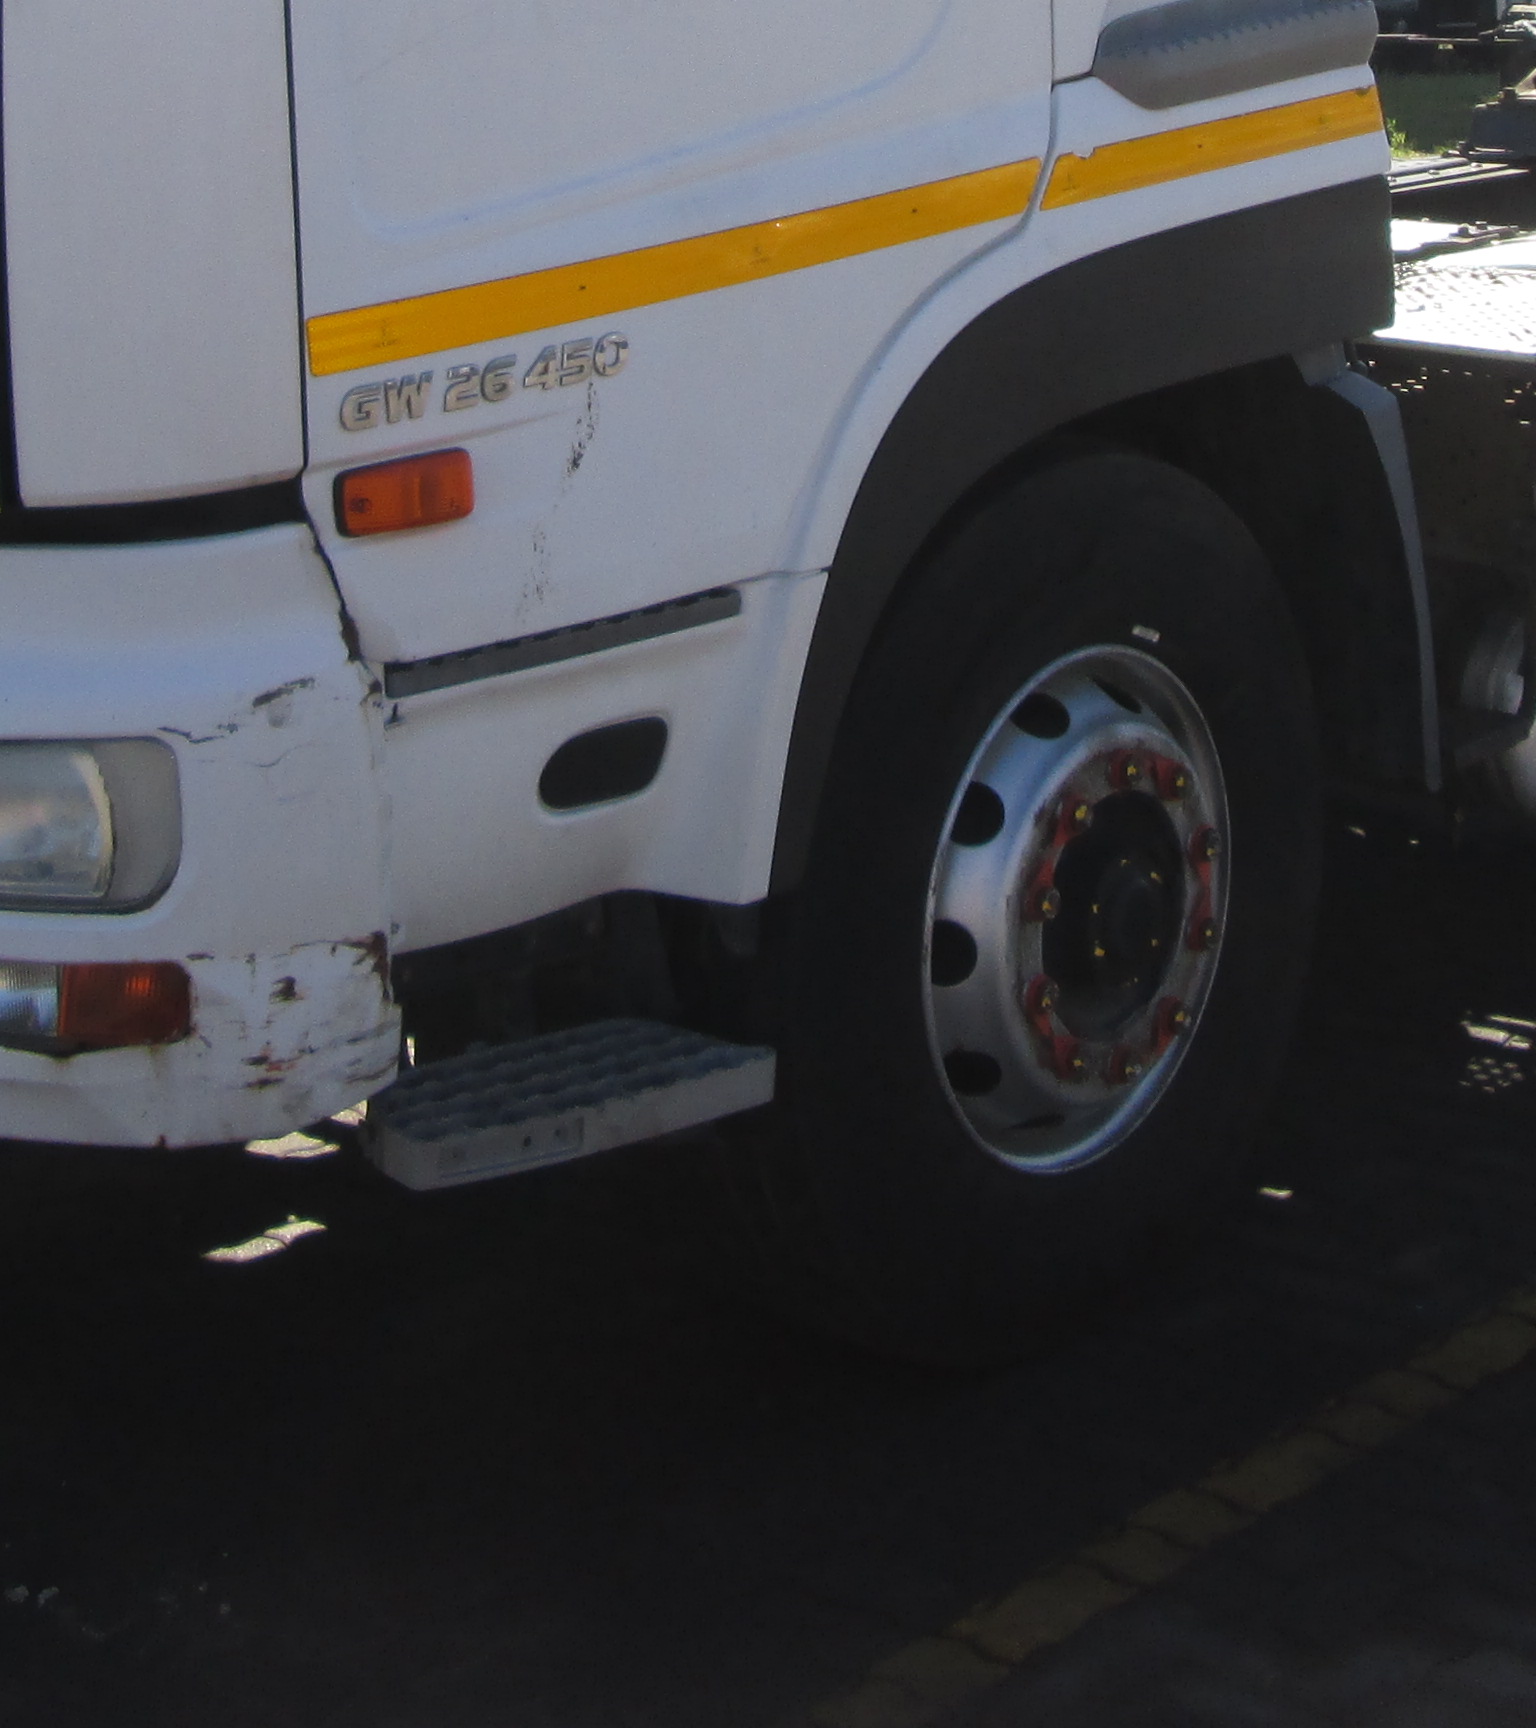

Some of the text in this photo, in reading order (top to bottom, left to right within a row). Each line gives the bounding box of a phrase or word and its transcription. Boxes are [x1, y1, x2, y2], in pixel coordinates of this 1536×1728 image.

[339, 330, 630, 432] GW 26 450
